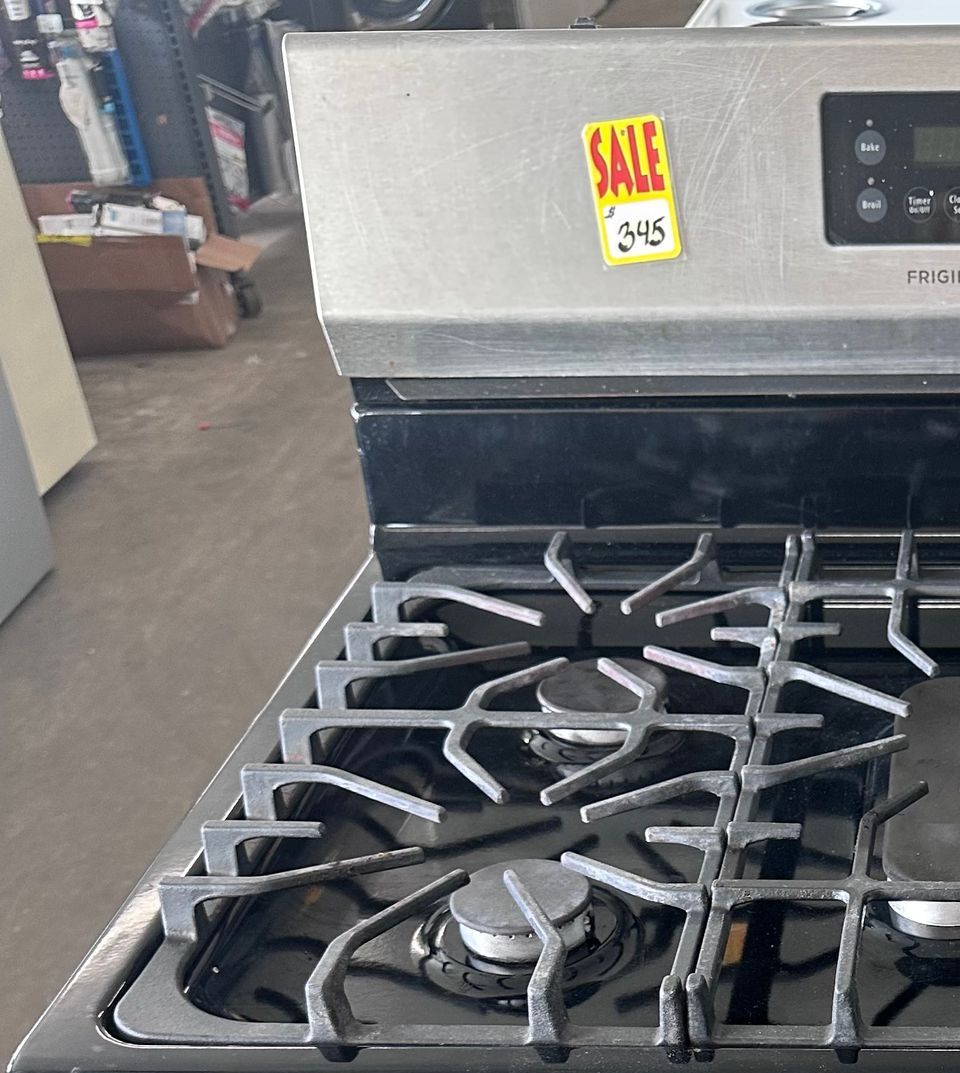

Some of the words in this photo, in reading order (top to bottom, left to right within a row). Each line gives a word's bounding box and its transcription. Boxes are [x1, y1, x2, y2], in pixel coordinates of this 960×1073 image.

[860, 142, 881, 153] Bake
[590, 121, 665, 199] SALE
[861, 199, 882, 211] Broil
[908, 196, 932, 206] Timer
